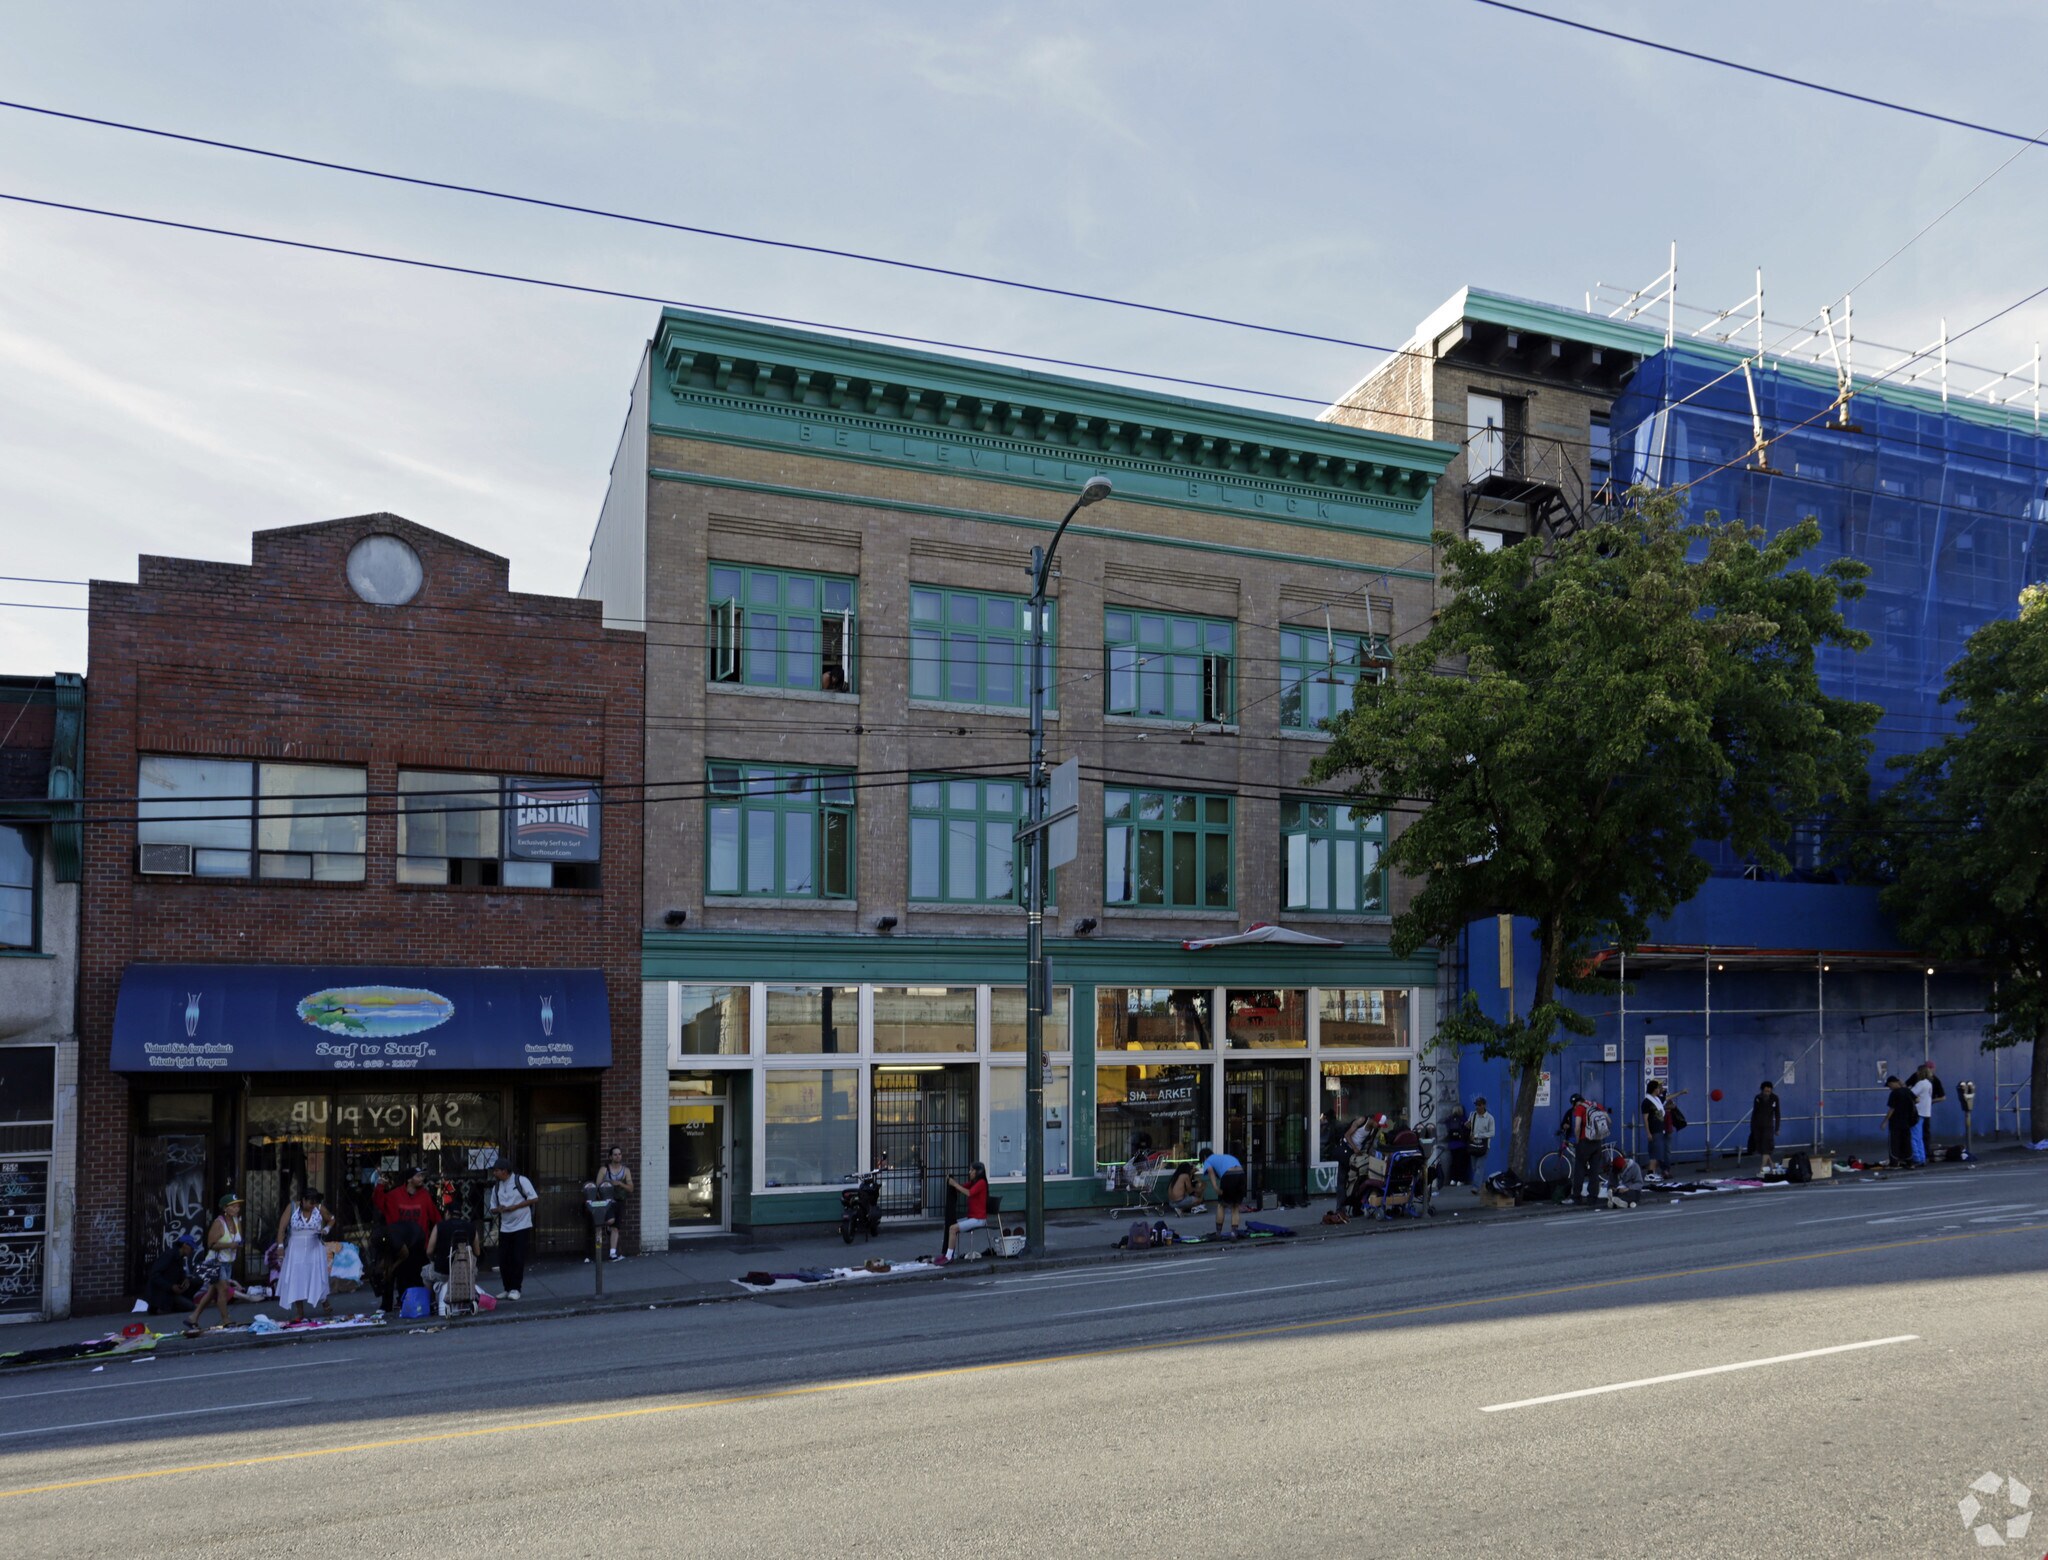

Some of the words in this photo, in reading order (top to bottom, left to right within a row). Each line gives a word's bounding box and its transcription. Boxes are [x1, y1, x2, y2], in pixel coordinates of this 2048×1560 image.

[1188, 481, 1329, 518] BLOCK
[517, 839, 548, 848] Exclusively
[549, 839, 561, 847] Serf
[530, 848, 572, 857] serftosurf.com
[1258, 1032, 1275, 1043] 265
[144, 1042, 171, 1054] Natural
[171, 1042, 188, 1053] Skin
[188, 1043, 204, 1054] Care
[204, 1043, 233, 1054] Products
[316, 1042, 358, 1058] Serf
[360, 1043, 380, 1055] to
[384, 1042, 429, 1057] Surf
[149, 1056, 176, 1067] Private
[175, 1056, 195, 1069] Label
[196, 1057, 228, 1069] Program
